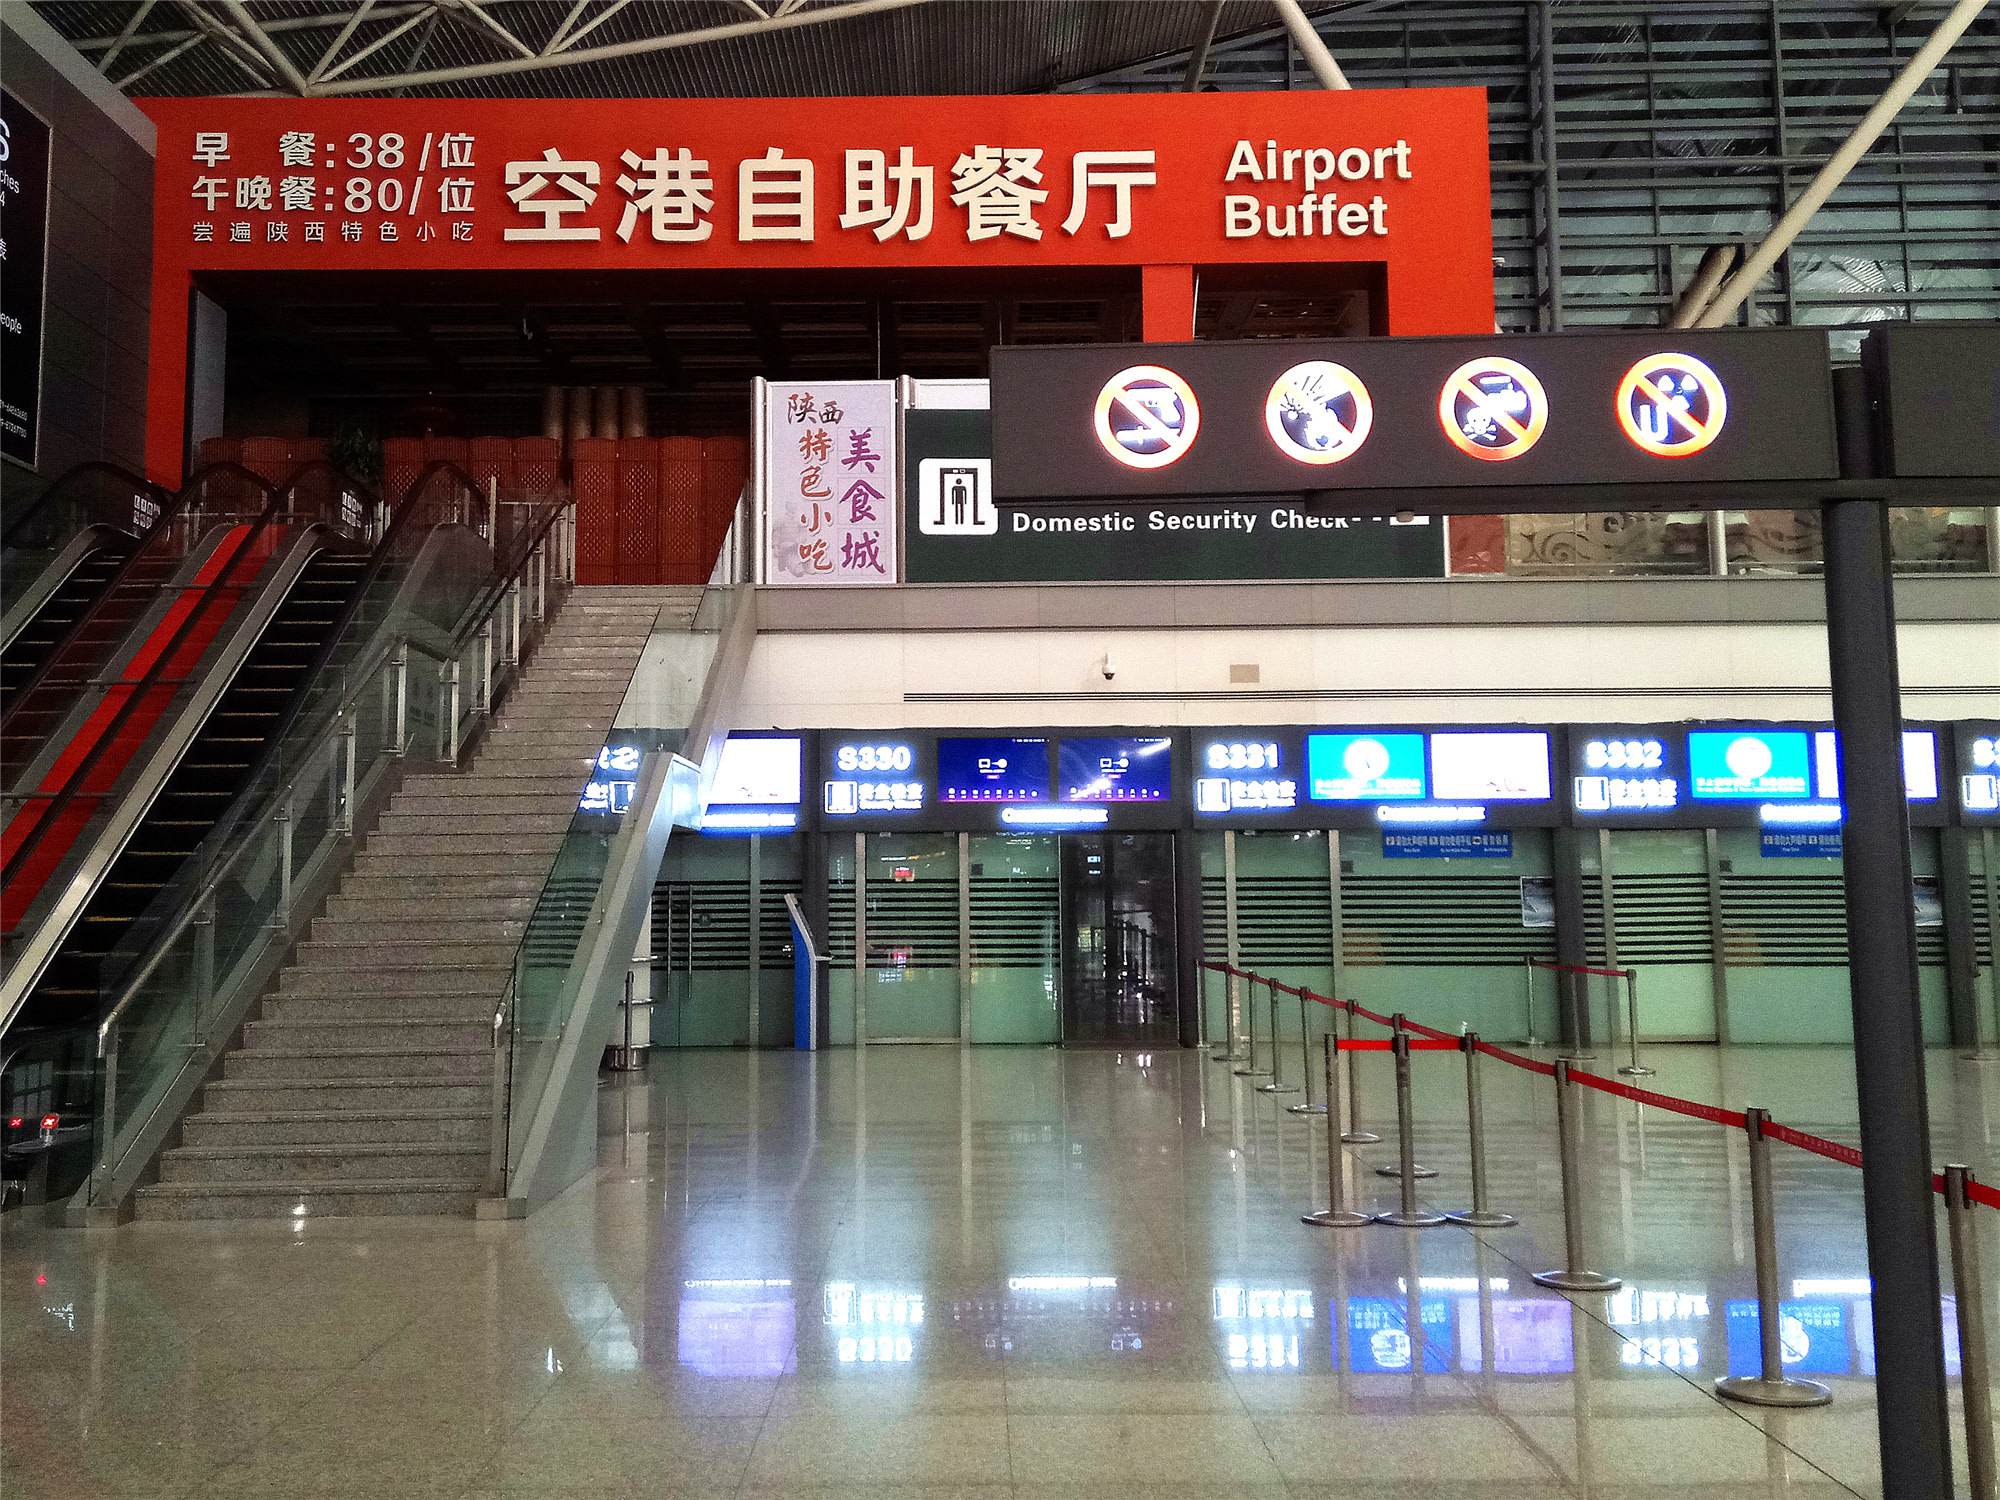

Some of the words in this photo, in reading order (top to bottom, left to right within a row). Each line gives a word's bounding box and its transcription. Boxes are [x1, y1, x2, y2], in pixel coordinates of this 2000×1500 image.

[1225, 139, 1413, 192] Airport
[503, 145, 1157, 243] 空港自助餐厅
[1225, 193, 1388, 237] Buffet
[192, 221, 474, 243] 尝遍陕西特色小吃
[787, 392, 845, 425] 陕西
[798, 427, 835, 571] 特色小吃
[838, 427, 886, 574] 美食城
[1012, 512, 1136, 533] Domestic
[1148, 509, 1258, 533] Security
[837, 745, 912, 771] S330
[1207, 743, 1280, 770] S331
[1586, 741, 1663, 768] S332
